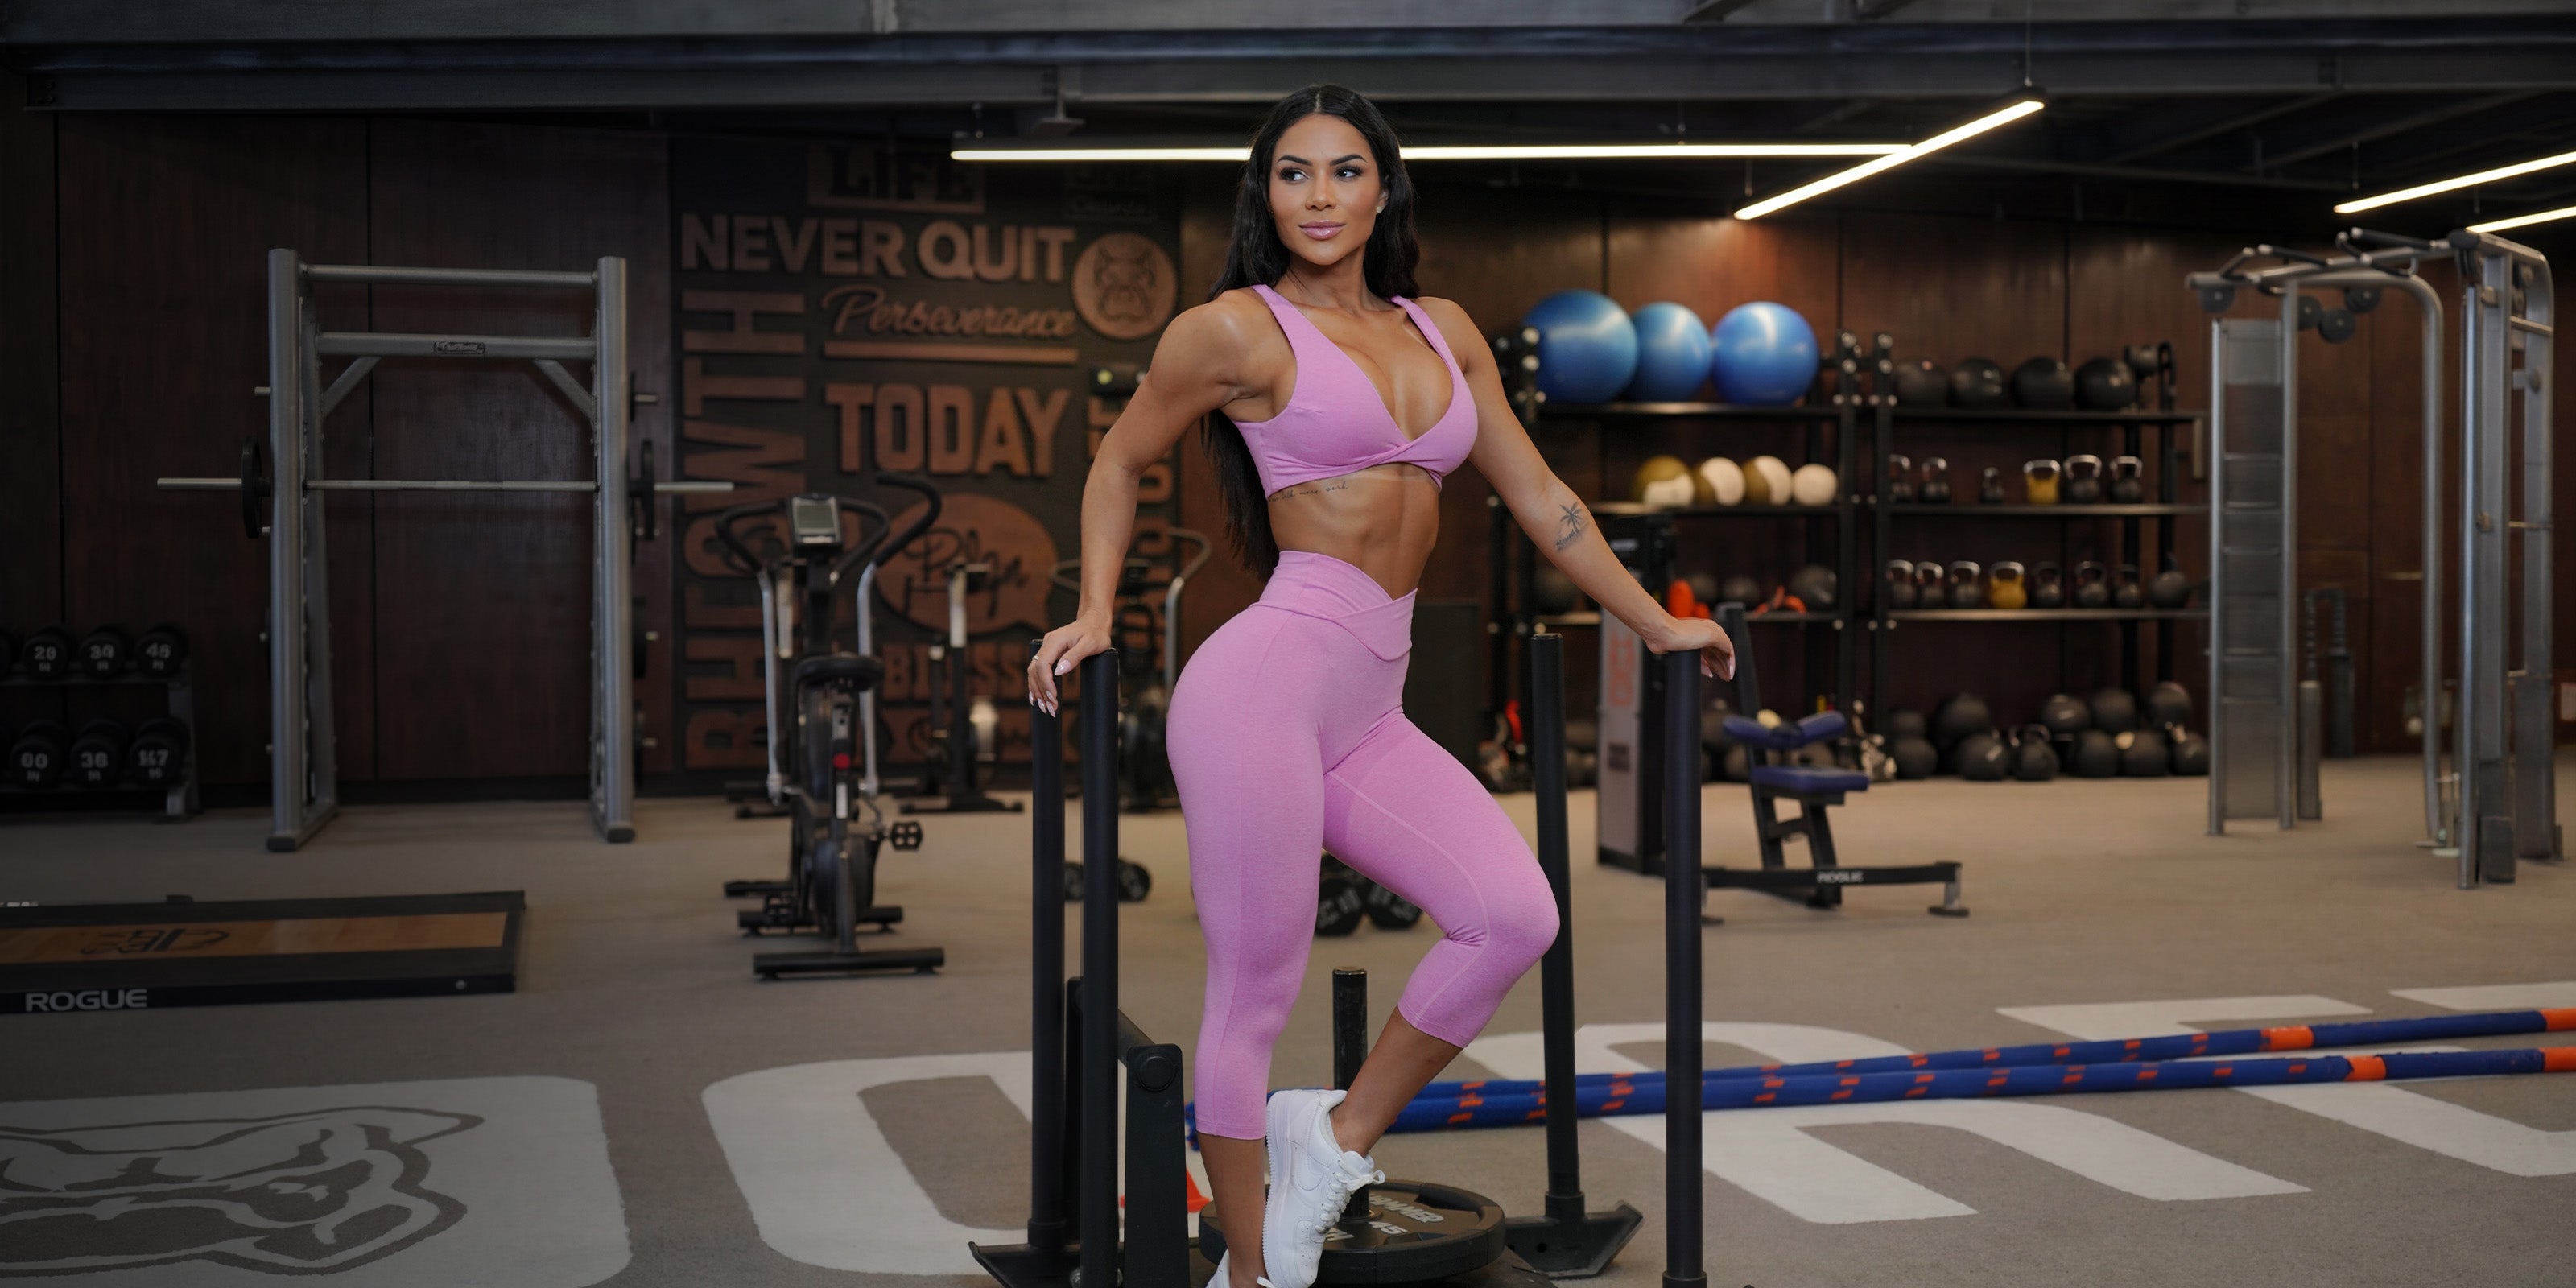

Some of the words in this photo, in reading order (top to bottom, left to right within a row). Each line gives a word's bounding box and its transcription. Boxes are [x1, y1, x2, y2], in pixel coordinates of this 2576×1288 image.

[681, 213, 906, 278] NEVER
[917, 220, 1077, 282] QUIT
[822, 284, 1076, 338] Perseverance
[824, 384, 1071, 477] TODAY
[26, 989, 148, 1013] ROGUE
